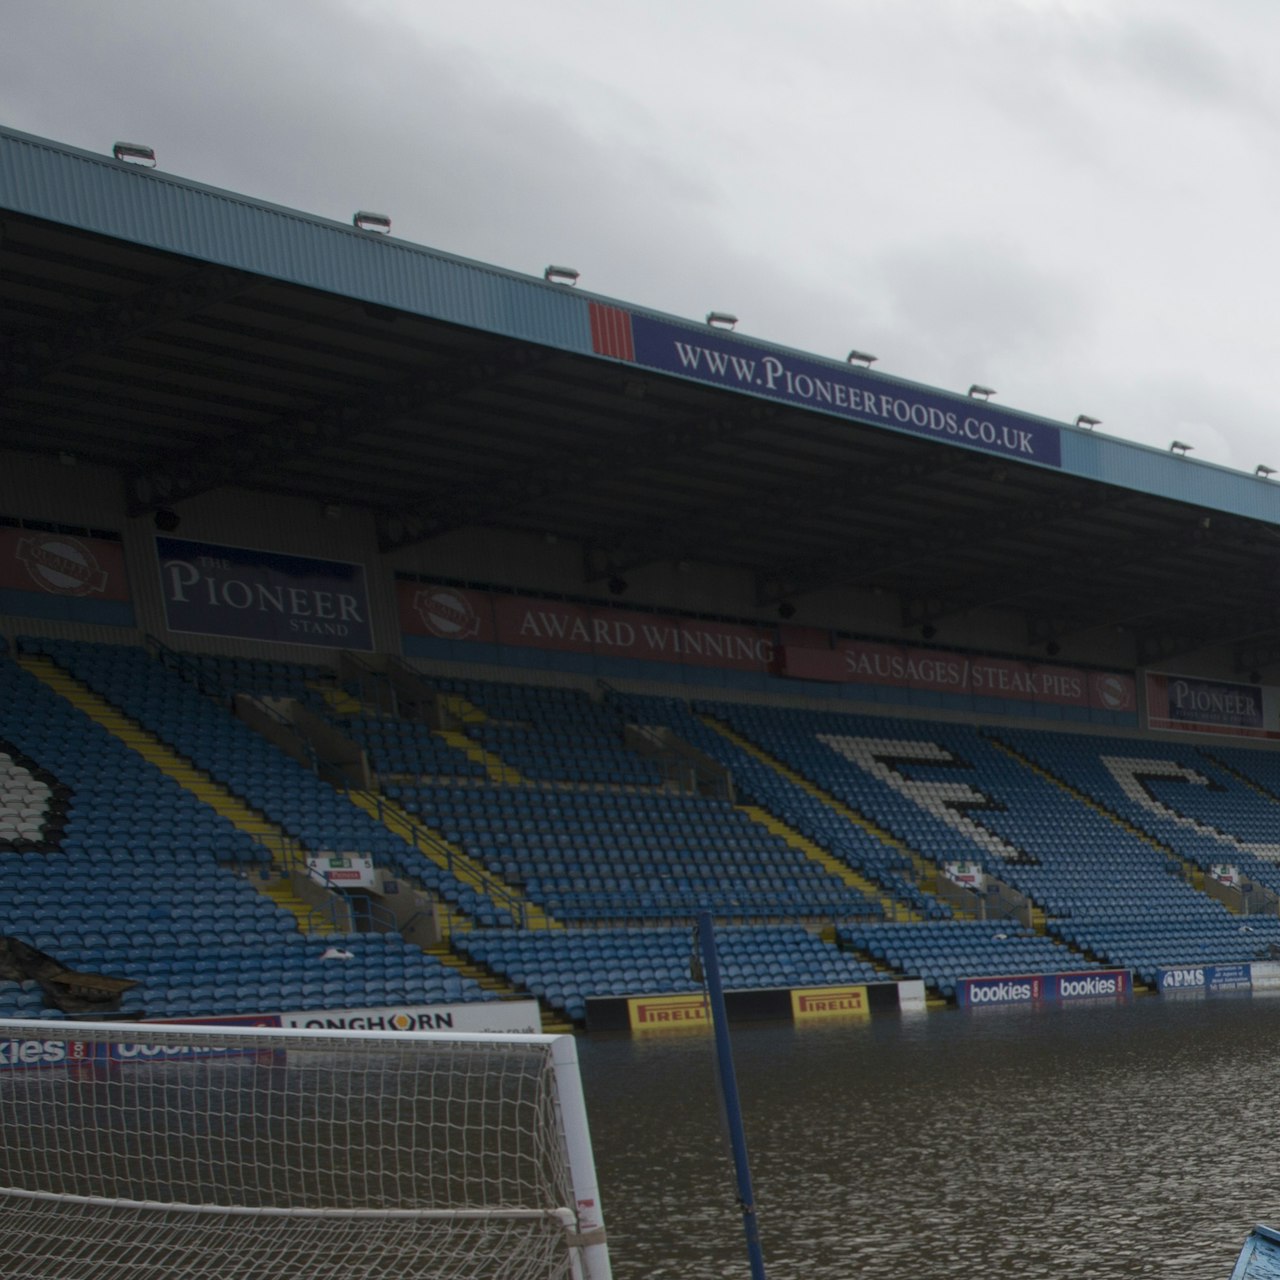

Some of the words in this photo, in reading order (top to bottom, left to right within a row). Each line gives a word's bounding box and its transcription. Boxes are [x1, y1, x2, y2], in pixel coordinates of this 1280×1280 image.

[200, 556, 230, 570] THE
[164, 560, 364, 622] PIONEER
[290, 619, 349, 637] STAND
[519, 609, 635, 647] AWARD
[641, 624, 774, 664] WINNING
[1042, 673, 1081, 697] PIES
[970, 983, 1031, 1002] bookies
[1060, 976, 1115, 997] bookies
[799, 991, 862, 1012] PIRELLI
